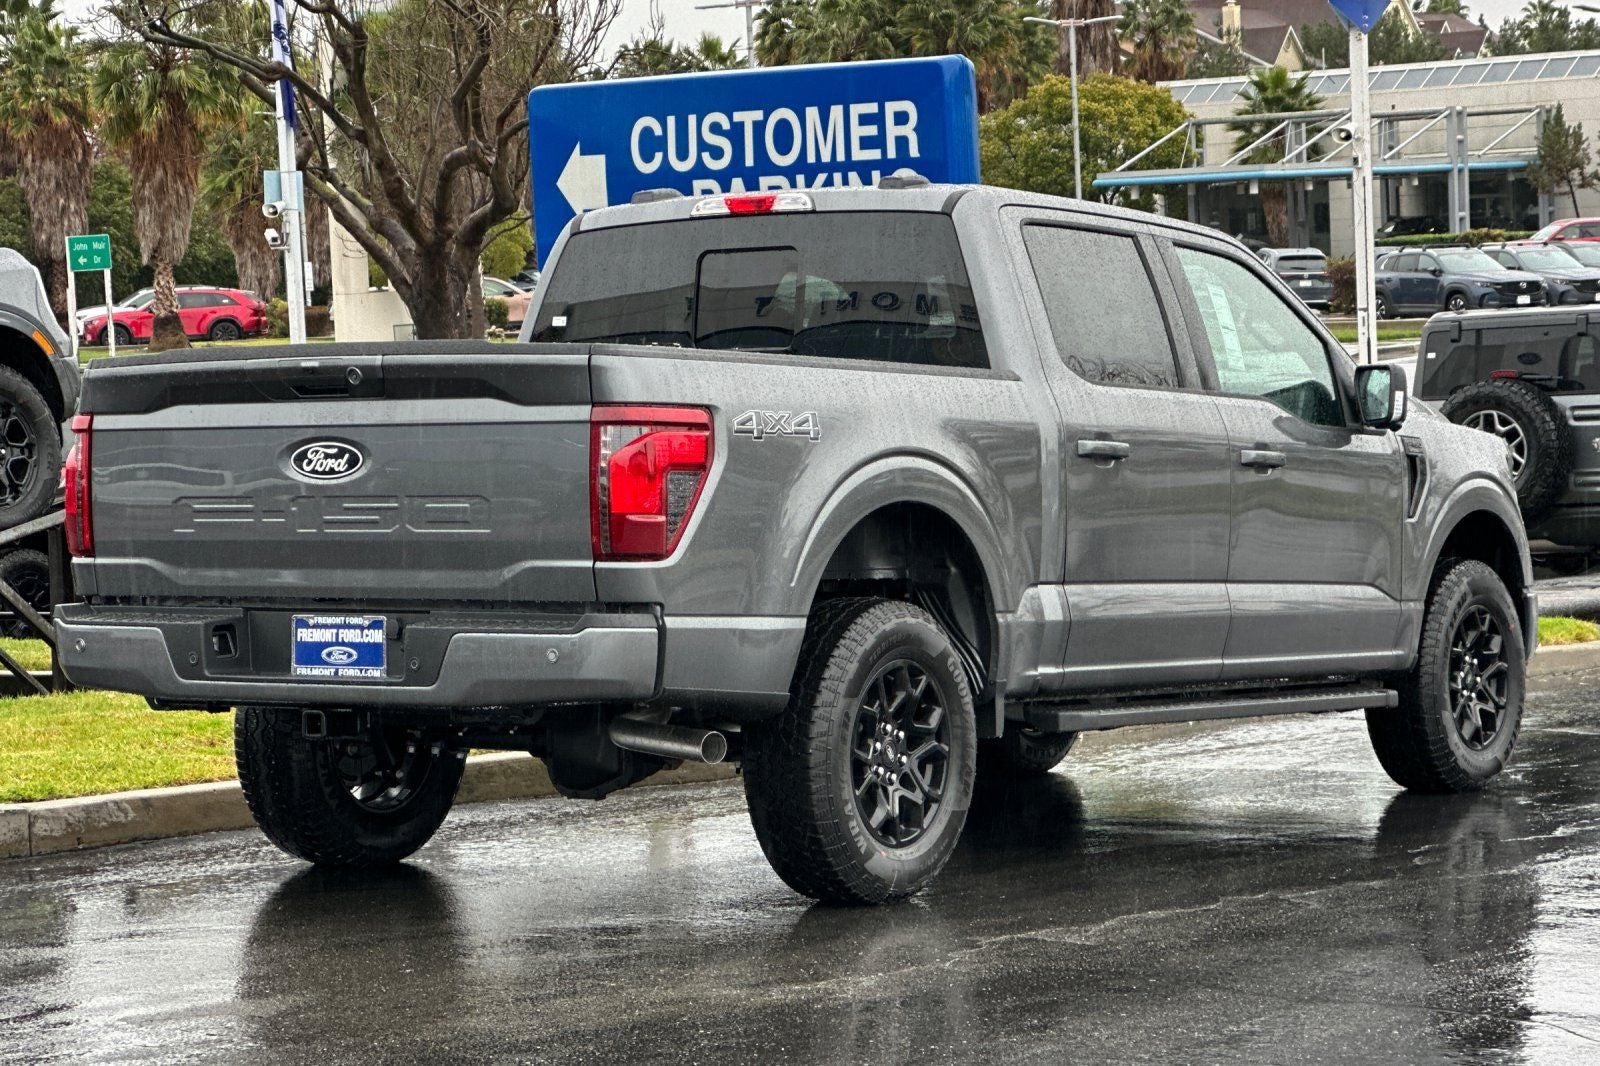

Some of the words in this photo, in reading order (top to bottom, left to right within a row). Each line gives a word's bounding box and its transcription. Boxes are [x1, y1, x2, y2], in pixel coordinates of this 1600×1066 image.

[630, 100, 921, 174] CUSTOMER
[73, 243, 88, 251] John
[92, 241, 105, 250] Muir
[93, 255, 101, 264] Dr
[302, 446, 350, 472] Ford
[172, 494, 492, 533] F-150
[314, 616, 344, 625] FREMONT
[346, 617, 364, 625] FORD
[297, 628, 337, 642] FREMONT
[338, 628, 383, 643] FORD.COM
[330, 649, 348, 661] Ford
[296, 667, 336, 676] FREMONT
[338, 668, 381, 677] FORD.COM
